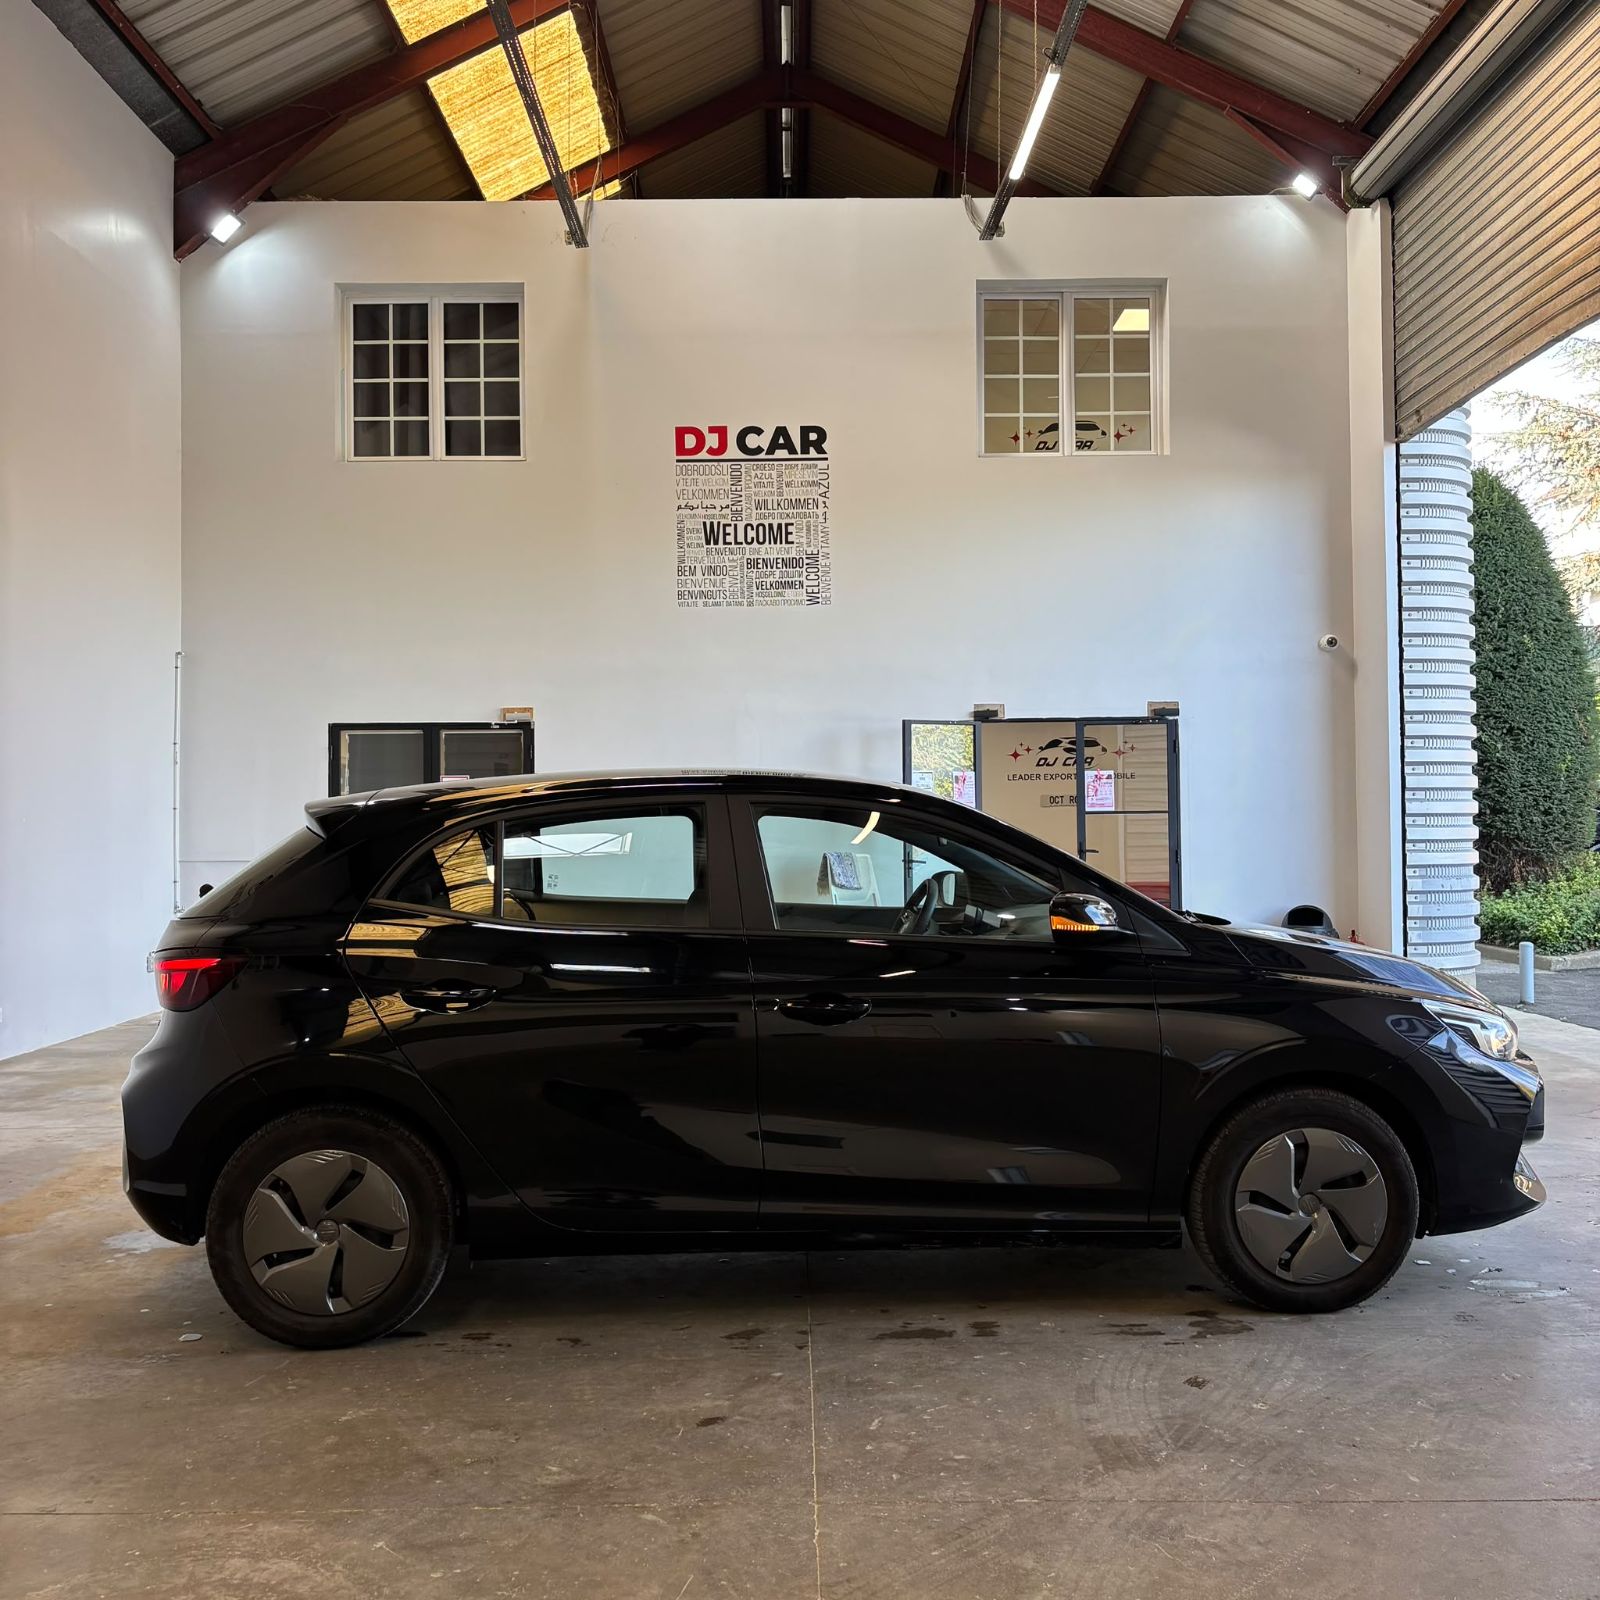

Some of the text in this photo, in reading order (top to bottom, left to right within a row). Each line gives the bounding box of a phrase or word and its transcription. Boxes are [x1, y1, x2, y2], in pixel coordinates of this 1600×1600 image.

[675, 426, 828, 457] DJ CAR
[1034, 440, 1058, 450] DJ
[818, 464, 830, 500] AZUL
[676, 488, 730, 500] VELKOMMEN
[730, 464, 743, 522] BIENVENIDO
[754, 498, 818, 511] WILLKOMMEN
[702, 521, 794, 546] WELCOME
[706, 546, 746, 556] BENVENUTO
[746, 557, 804, 570] BIENVENIDO
[678, 565, 728, 576] BEM VINDO
[677, 578, 726, 588] BIENVENUE
[805, 549, 820, 606] WELCOME
[755, 580, 804, 590] VELKOMMEN
[678, 590, 728, 600] BENVINGUTS
[1036, 756, 1059, 767] DJ
[1049, 796, 1064, 804] OCT
